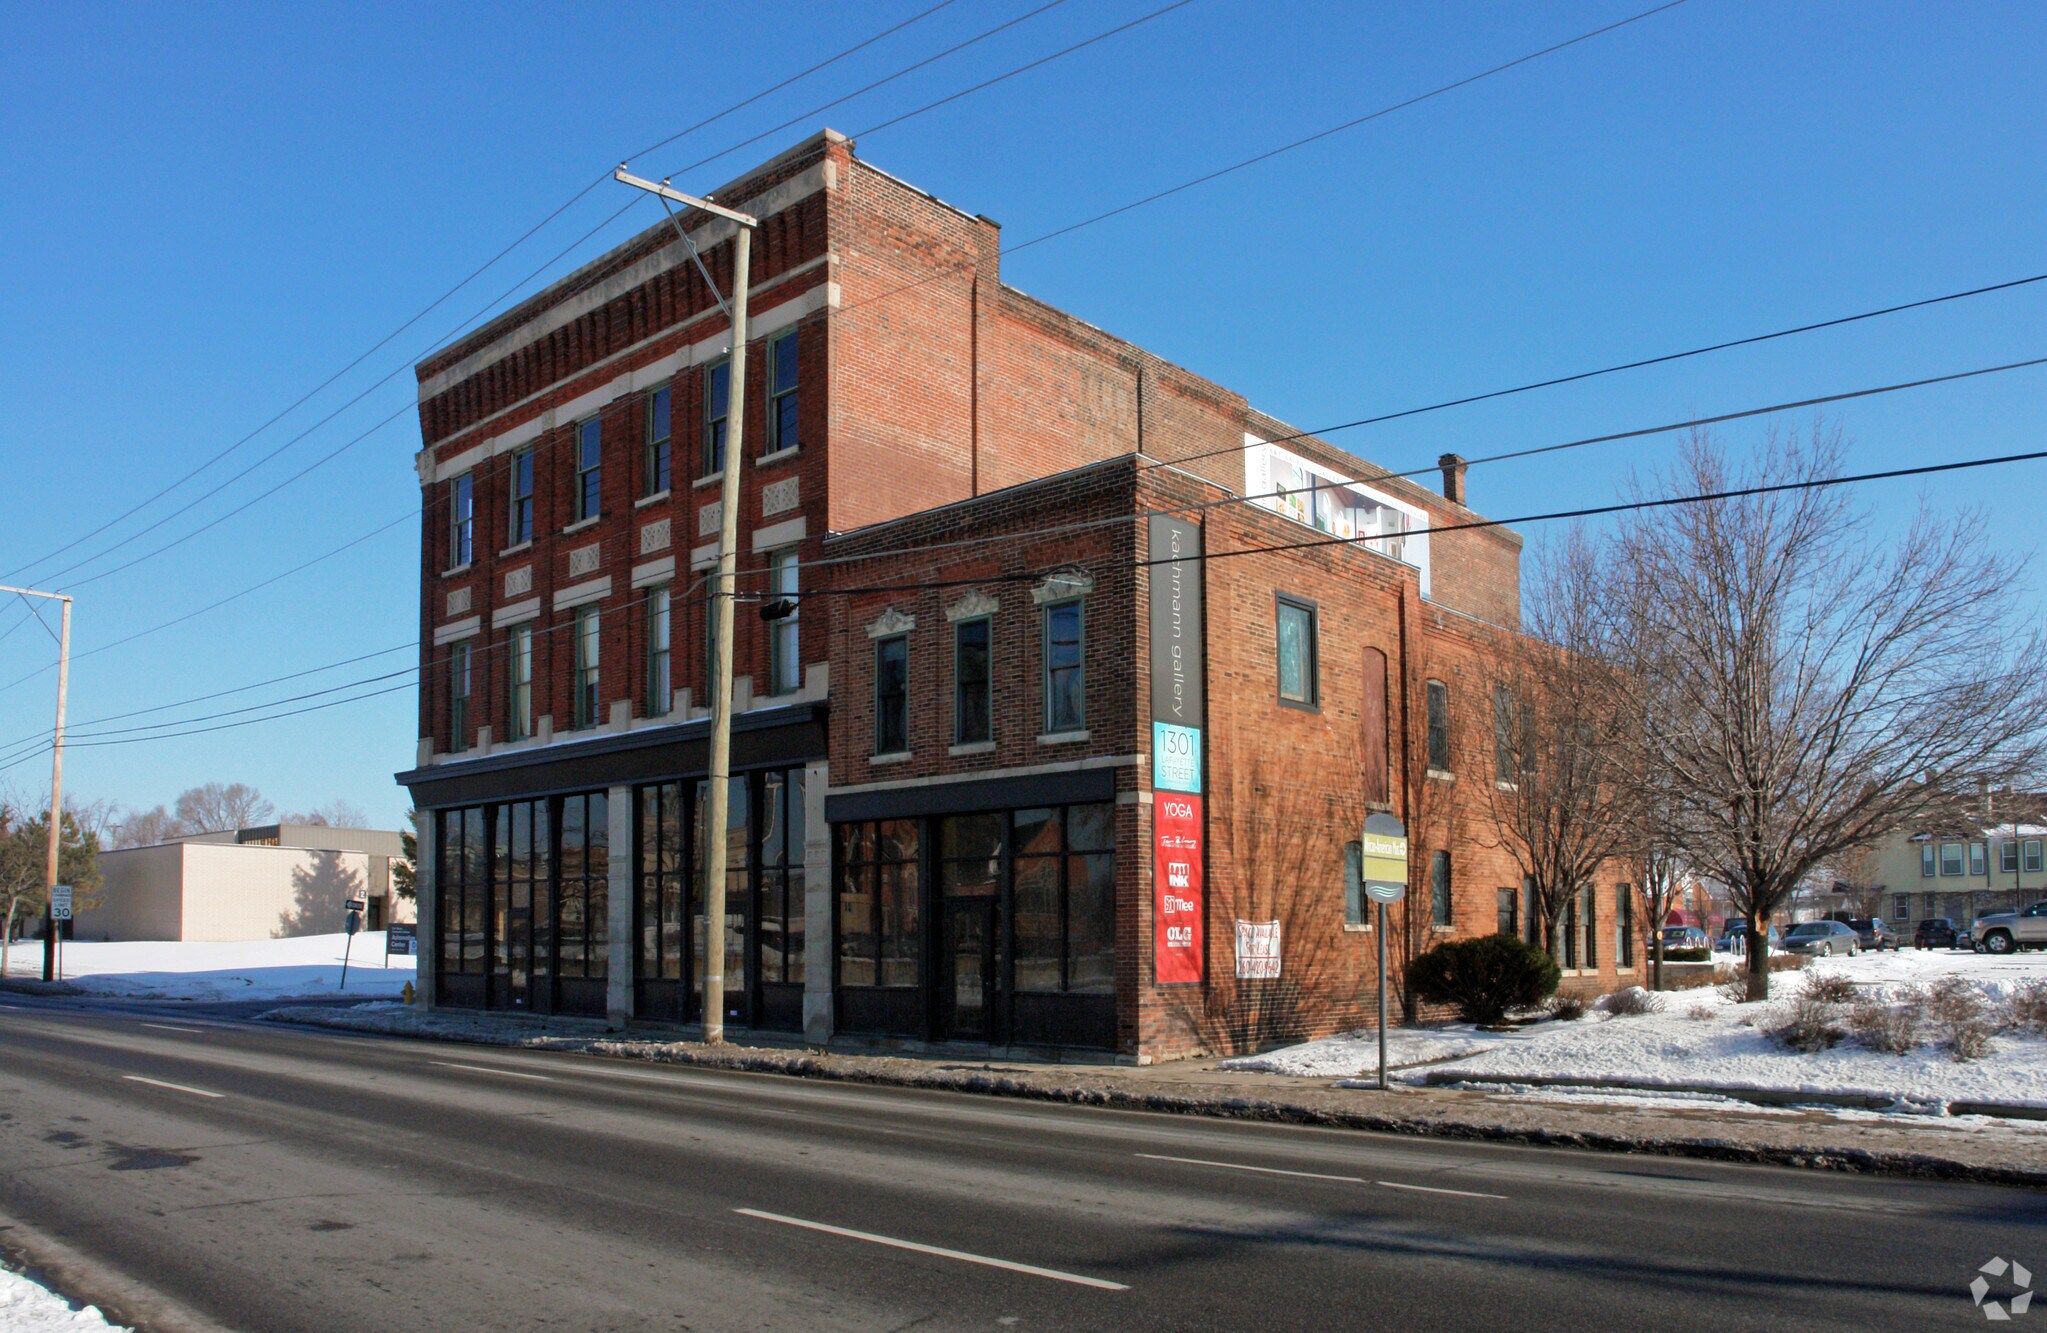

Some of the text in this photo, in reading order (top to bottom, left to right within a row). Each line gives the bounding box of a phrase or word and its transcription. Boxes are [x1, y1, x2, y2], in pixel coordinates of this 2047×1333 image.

[1171, 529, 1184, 717] kachmann gallery
[1160, 729, 1194, 756] 1301
[1161, 756, 1195, 767] LAFAYETTE
[1161, 766, 1195, 780] STREET
[1163, 802, 1193, 818] YOGA
[54, 908, 70, 917] 30
[1167, 926, 1192, 941] OLG
